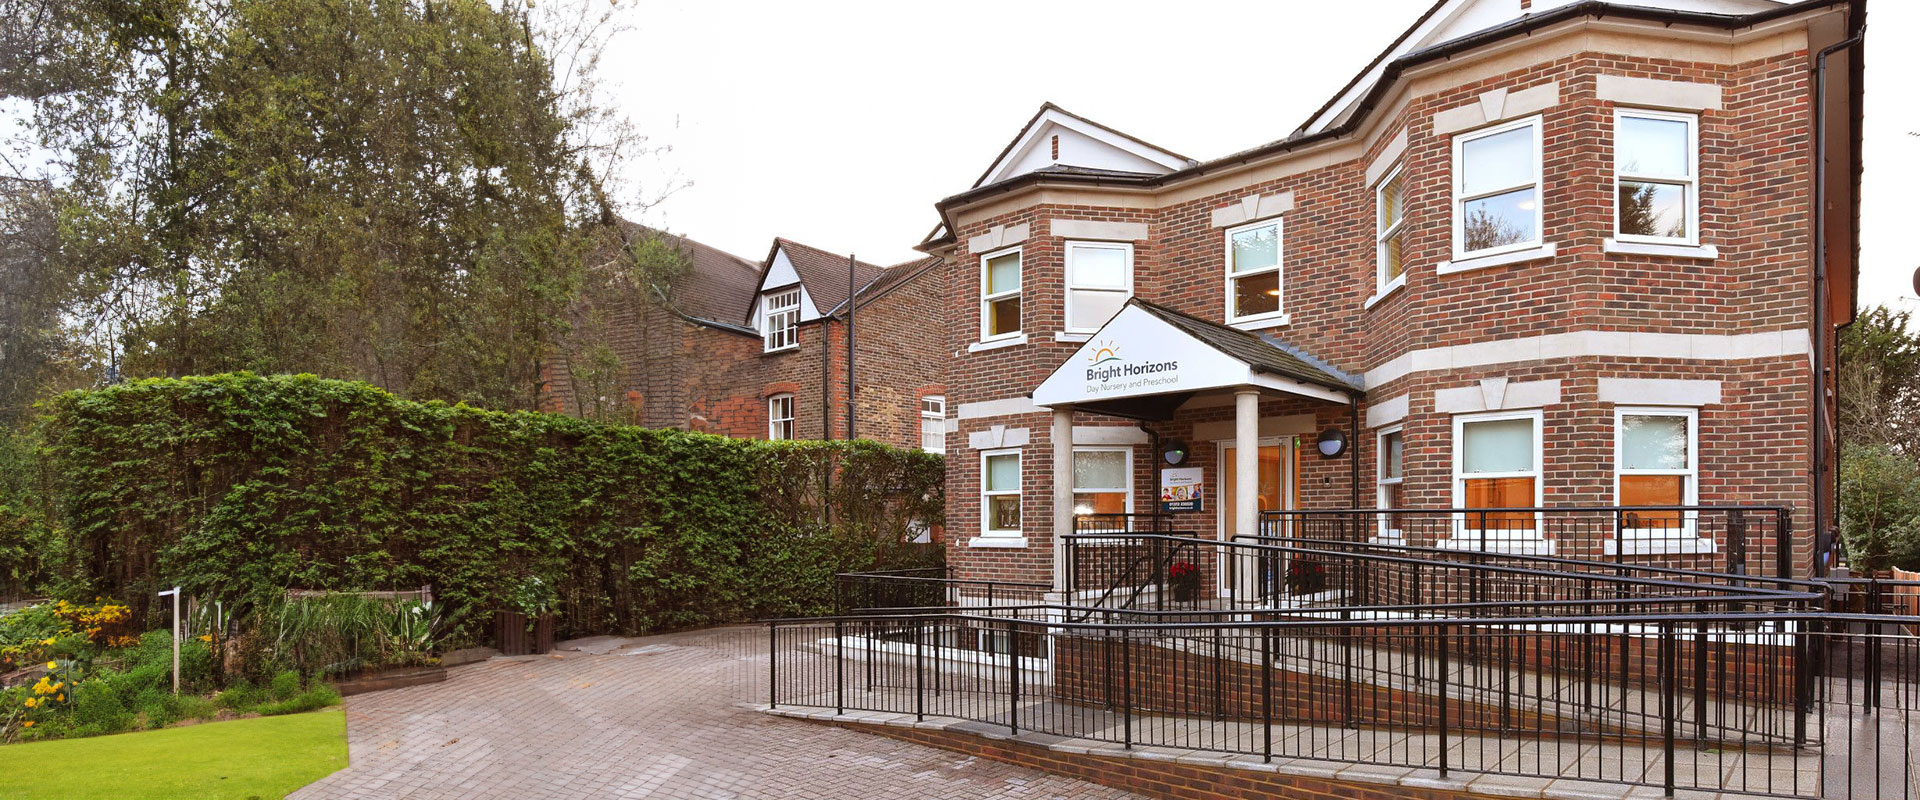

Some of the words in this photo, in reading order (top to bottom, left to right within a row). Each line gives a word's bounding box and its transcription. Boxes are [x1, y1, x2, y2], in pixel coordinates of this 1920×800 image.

[1086, 365, 1121, 382] Bright
[1124, 361, 1178, 376] Horizons
[1086, 385, 1099, 393] Day
[1100, 382, 1127, 392] Nursery
[1128, 380, 1141, 388] and
[1143, 375, 1179, 387] Preschool
